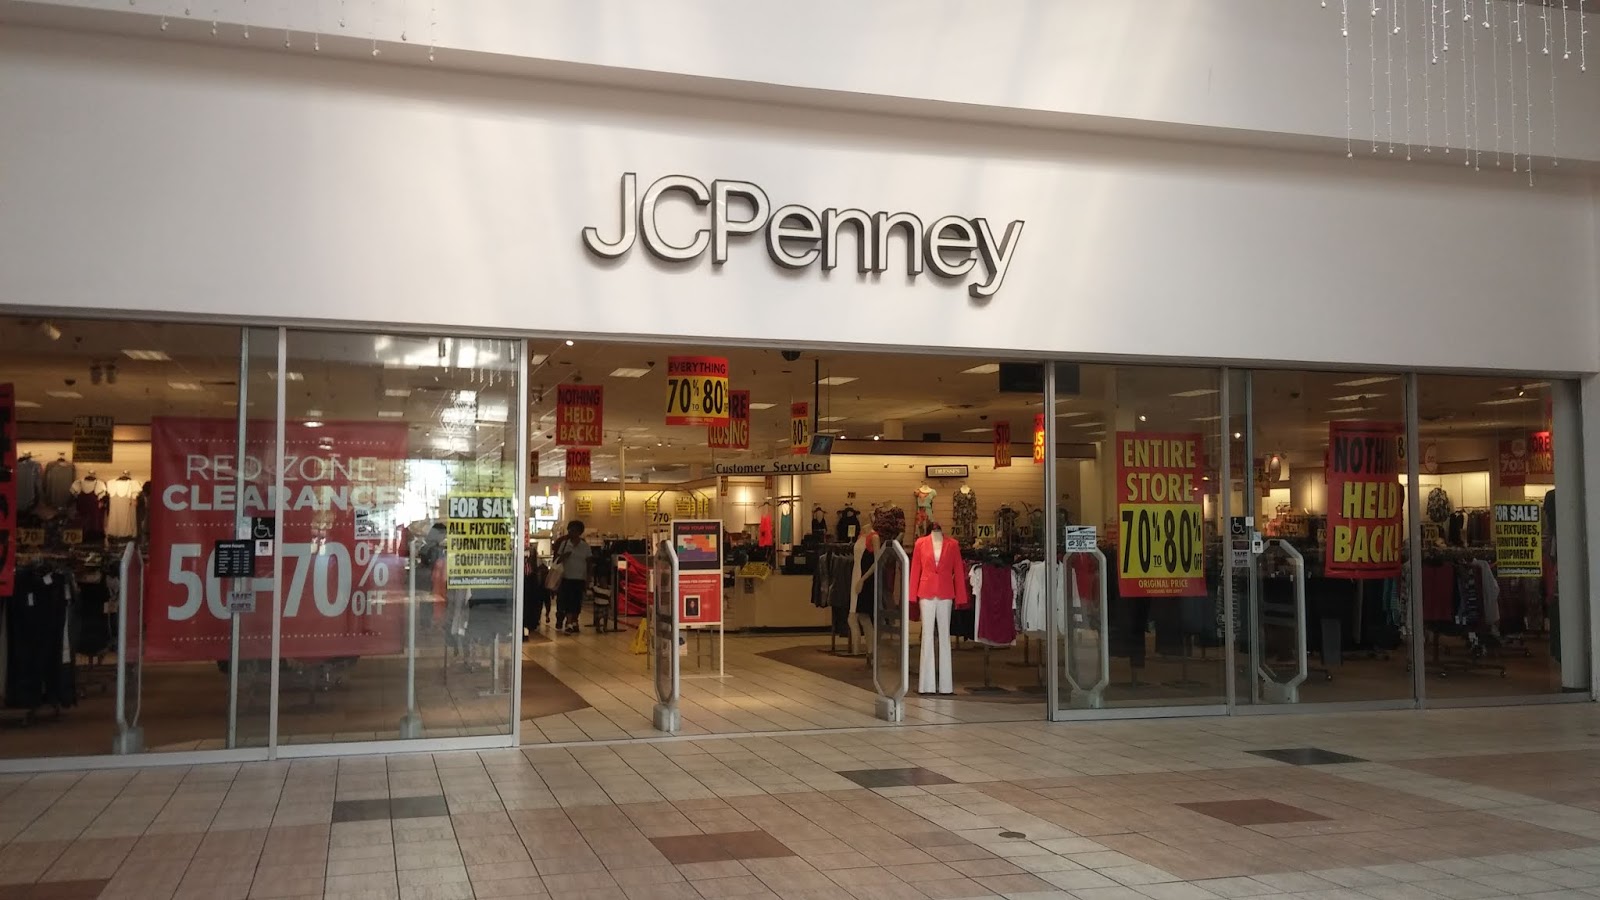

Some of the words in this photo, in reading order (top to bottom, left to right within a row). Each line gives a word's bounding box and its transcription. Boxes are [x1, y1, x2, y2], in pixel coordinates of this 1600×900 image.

[582, 172, 1025, 298] JCPenney
[668, 361, 726, 374] EVERYTHING
[558, 389, 600, 405] NOTHING
[564, 407, 595, 424] HELD
[560, 424, 599, 442] BACK!
[566, 451, 591, 466] STORE
[1122, 438, 1196, 469] ENTIRE
[186, 454, 263, 481] RED
[282, 455, 378, 482] ZONE
[715, 463, 766, 474] Customer
[773, 461, 821, 473] Service
[1126, 472, 1195, 503] STORE
[162, 484, 400, 512] CLEARANCE
[1342, 481, 1398, 519] HELD
[449, 497, 479, 518] FOR
[1510, 505, 1539, 522] SALE
[448, 522, 466, 535] ALL
[1504, 524, 1540, 536] FIXTURES,
[450, 538, 506, 551] FURNITURE
[1333, 524, 1400, 563] BACK!
[1531, 537, 1538, 548] &
[454, 553, 512, 567] EQUIPMENT
[1153, 554, 1162, 567] TO
[1138, 579, 1169, 588] ORIGINAL
[1170, 579, 1189, 588] PRICE
[351, 590, 387, 617] OFF
